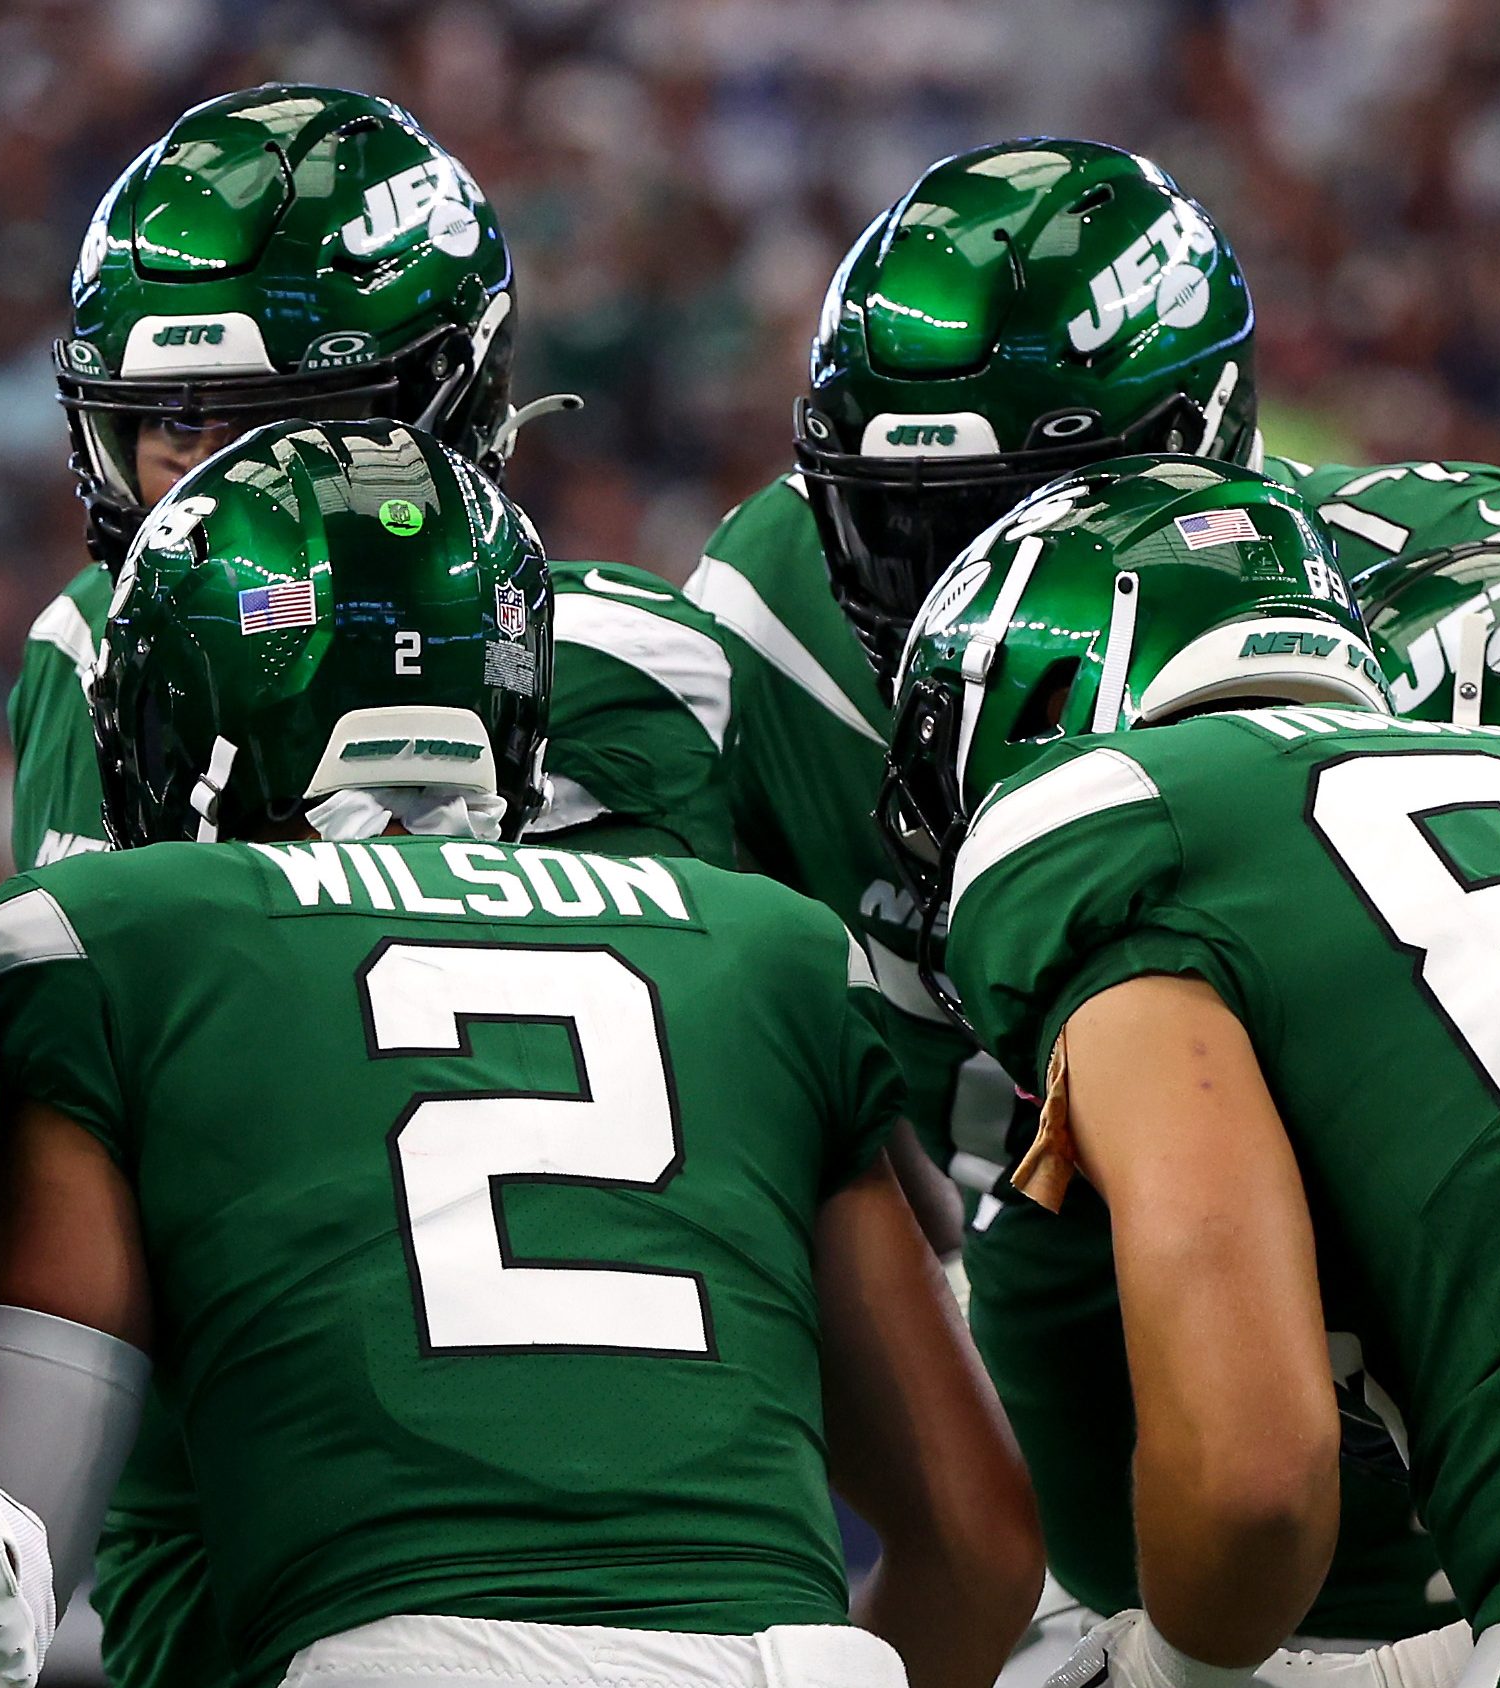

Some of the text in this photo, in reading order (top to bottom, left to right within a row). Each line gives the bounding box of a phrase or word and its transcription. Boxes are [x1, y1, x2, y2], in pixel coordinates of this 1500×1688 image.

[152, 323, 225, 347] JETS
[309, 352, 376, 370] OAKLEY
[886, 424, 958, 446] JETS
[1303, 554, 1351, 610] 89
[502, 605, 524, 631] NFL
[394, 631, 422, 675] 2
[1239, 631, 1342, 660] NEW
[247, 841, 694, 922] WILSON
[354, 935, 719, 1362] 2
